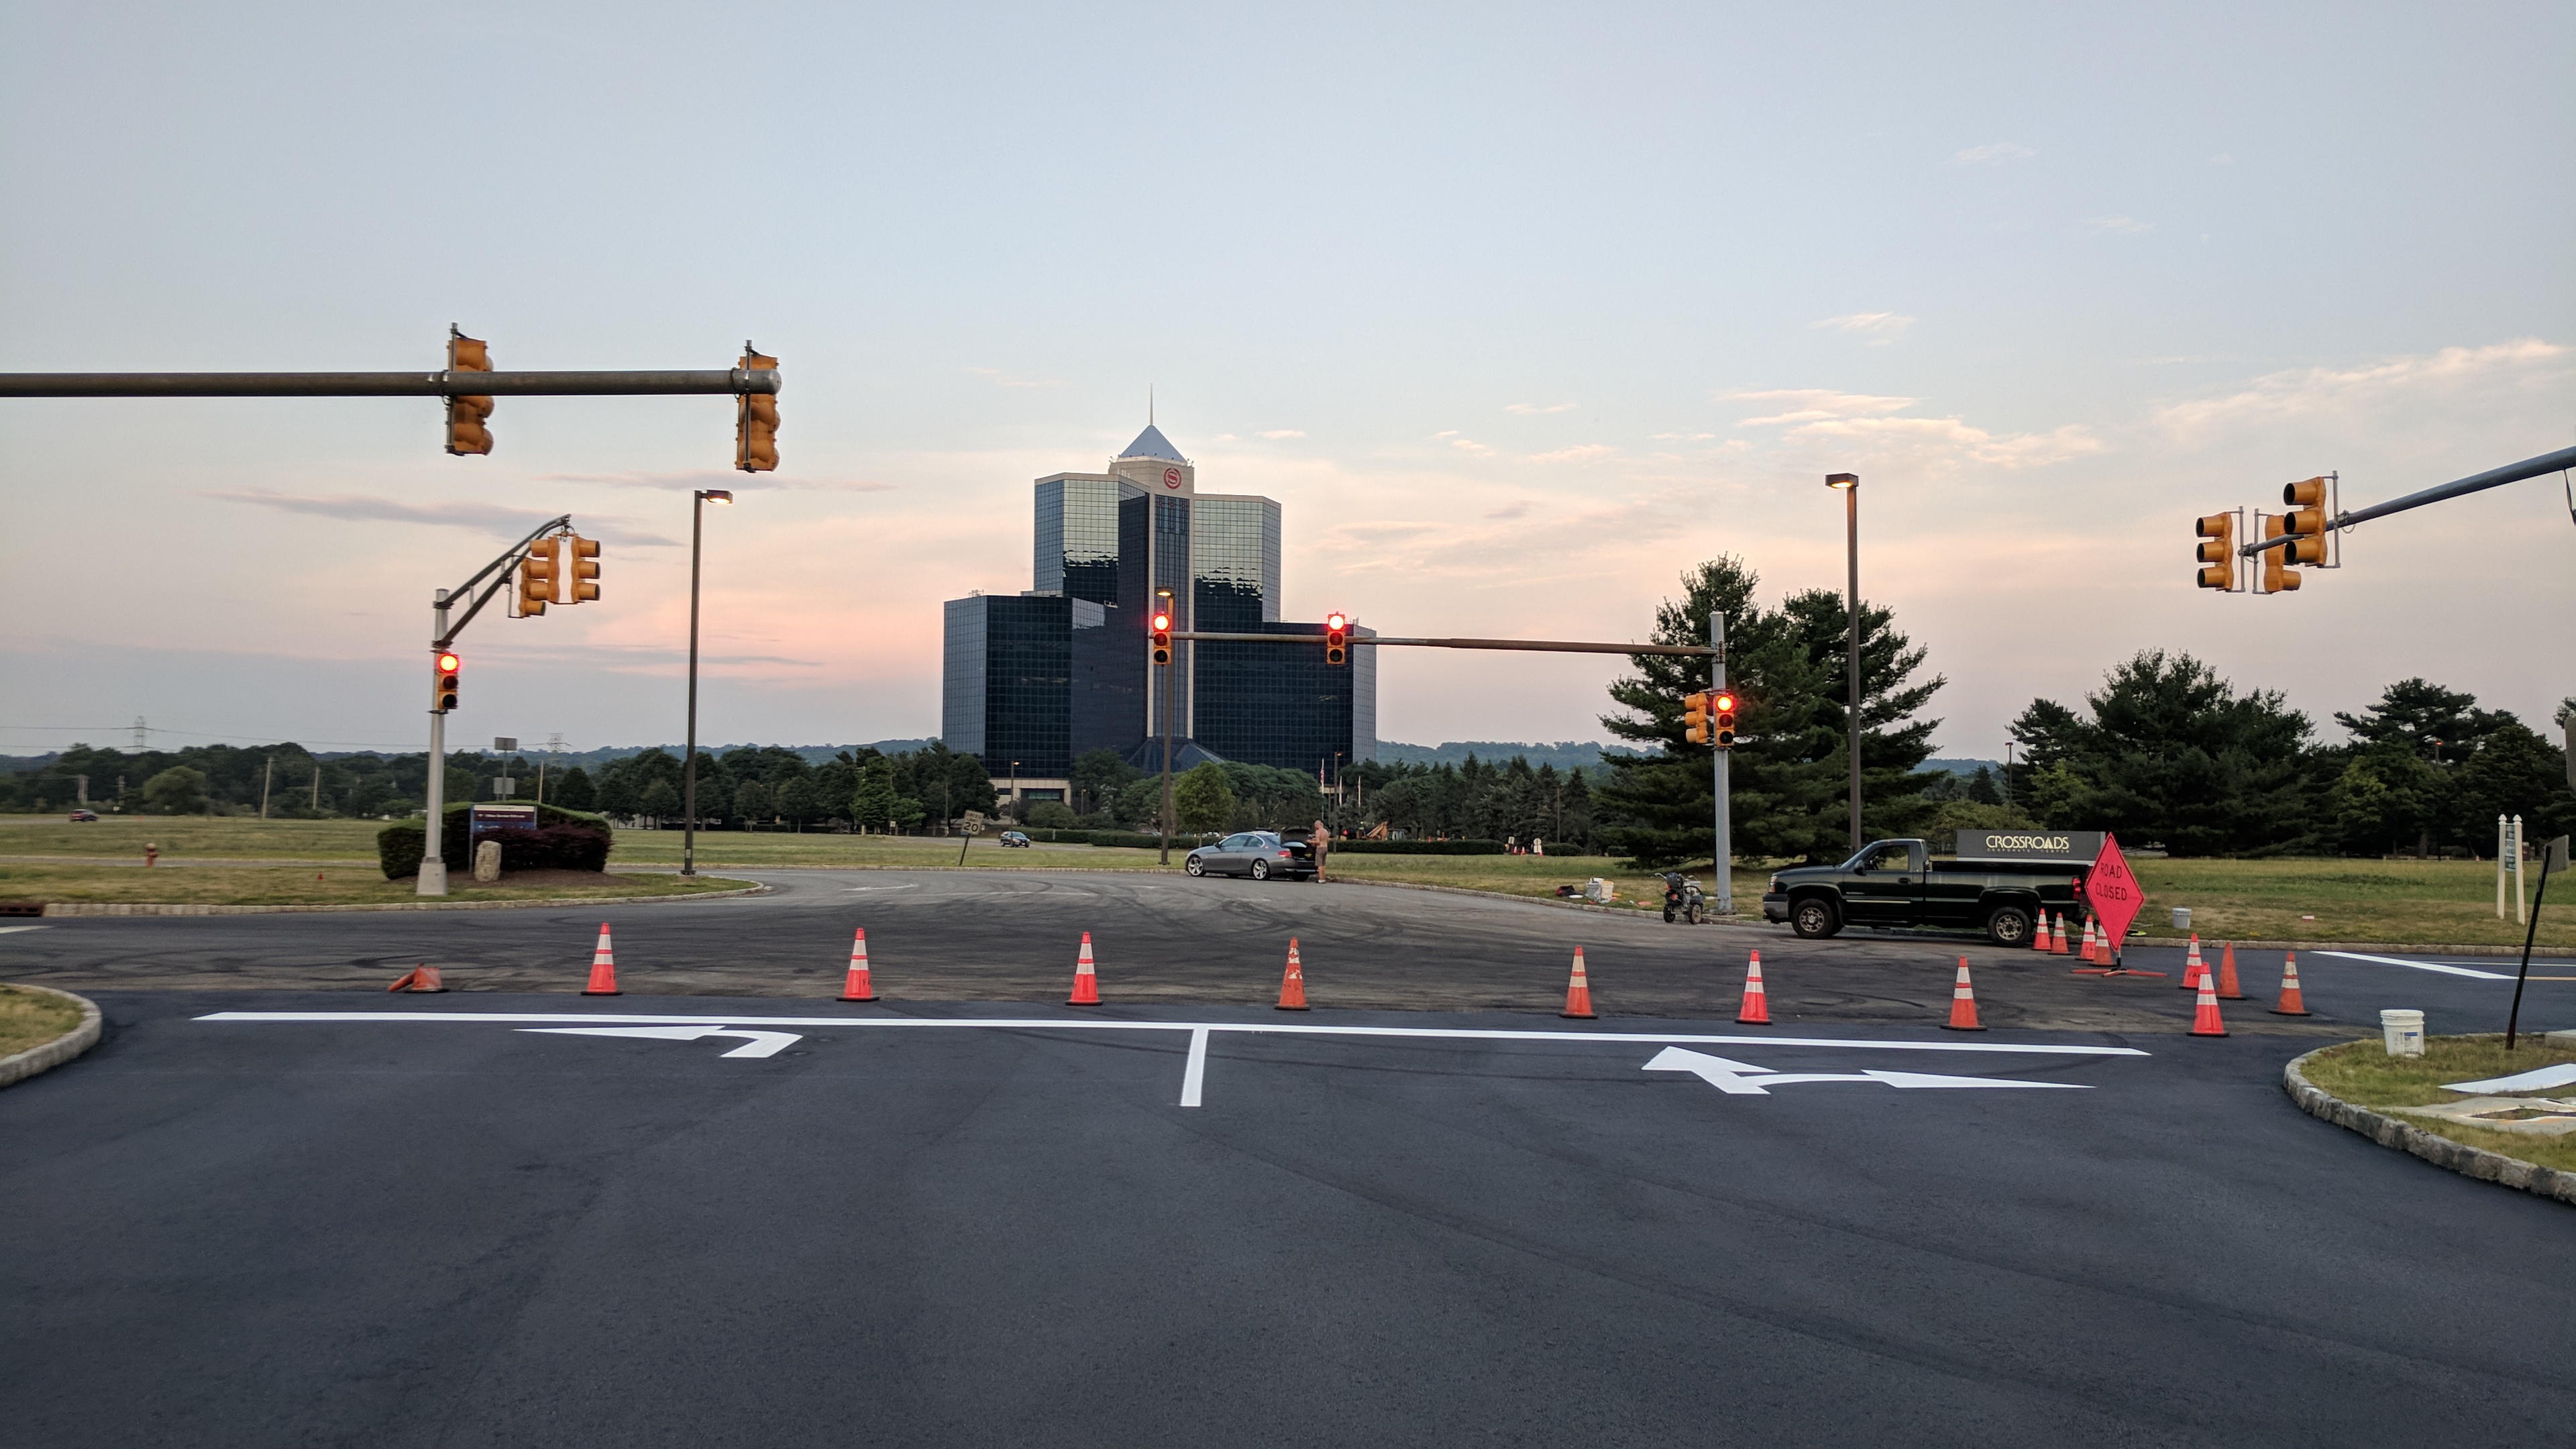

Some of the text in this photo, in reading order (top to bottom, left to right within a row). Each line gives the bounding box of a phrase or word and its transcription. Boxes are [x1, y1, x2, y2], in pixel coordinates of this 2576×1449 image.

[964, 822, 979, 832] 20
[1986, 835, 2070, 849] CROSSROADS
[2100, 863, 2122, 878] ROAD
[2095, 882, 2127, 900] CLOSED
